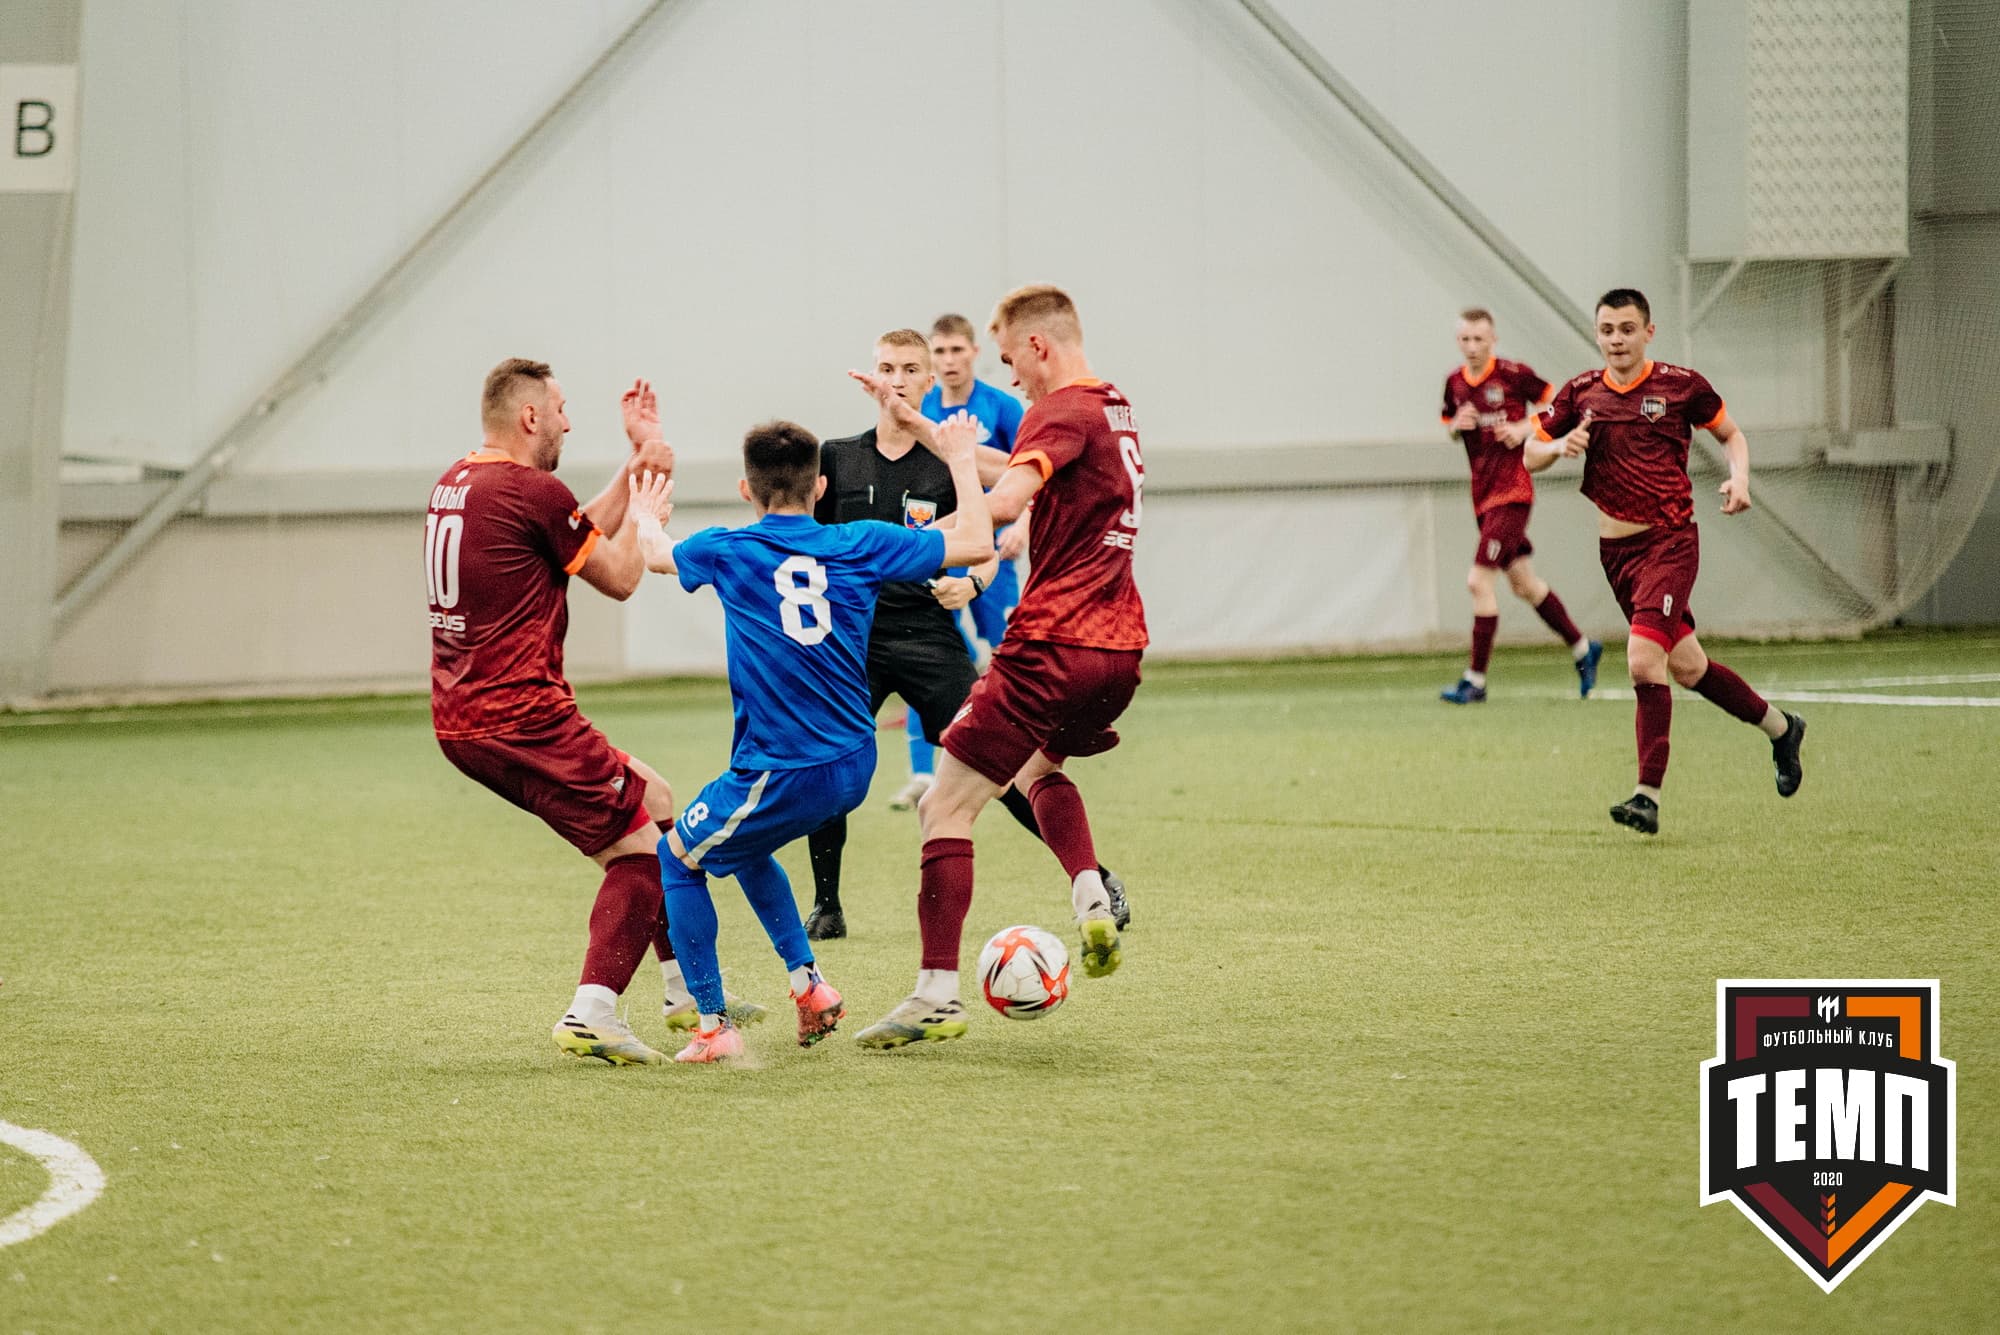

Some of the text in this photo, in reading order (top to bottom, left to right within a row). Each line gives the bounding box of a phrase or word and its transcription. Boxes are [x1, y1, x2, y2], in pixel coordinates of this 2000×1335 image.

[426, 513, 464, 609] 10
[773, 554, 833, 647] 8
[687, 802, 709, 828] 8
